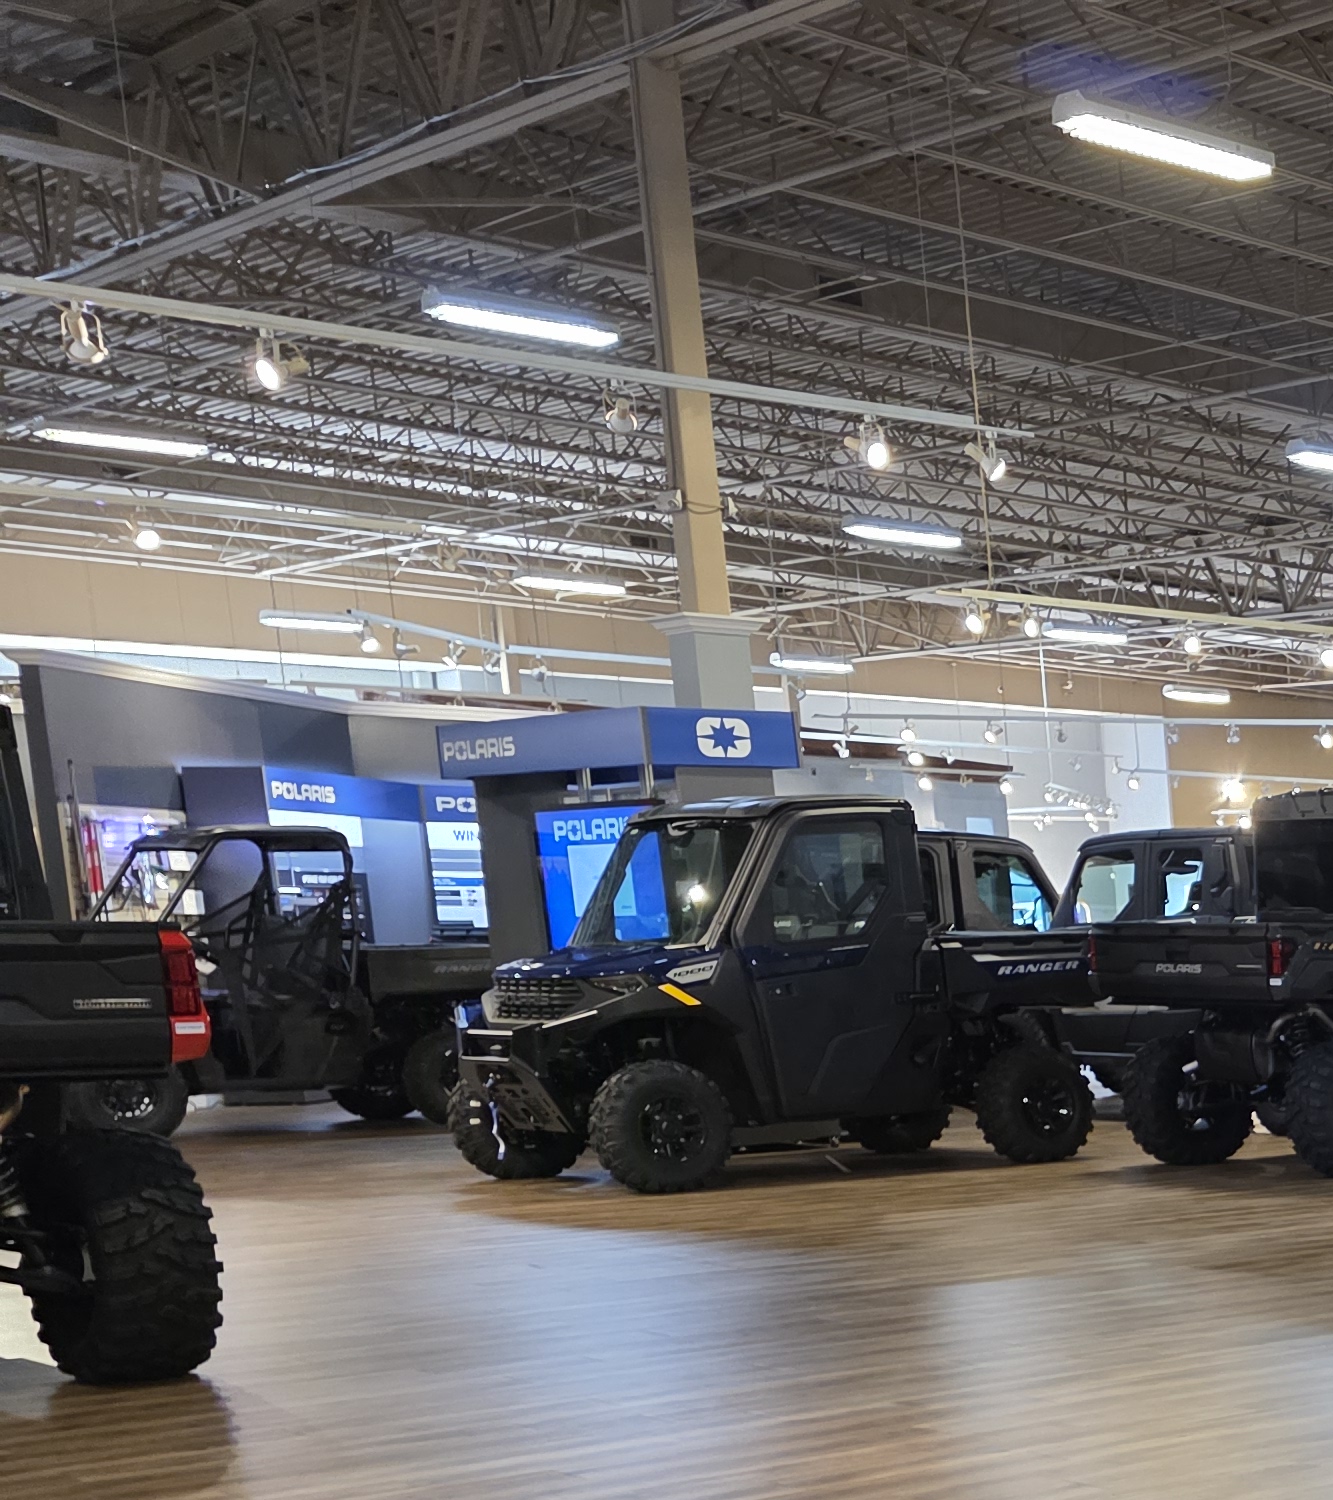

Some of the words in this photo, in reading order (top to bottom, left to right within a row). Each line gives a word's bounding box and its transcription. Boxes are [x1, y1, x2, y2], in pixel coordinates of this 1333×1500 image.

[443, 736, 516, 762] POLARIS
[271, 780, 336, 804] POLARIS
[673, 966, 715, 978] 1000
[998, 960, 1080, 976] RANGER
[1155, 962, 1202, 975] POLARIS
